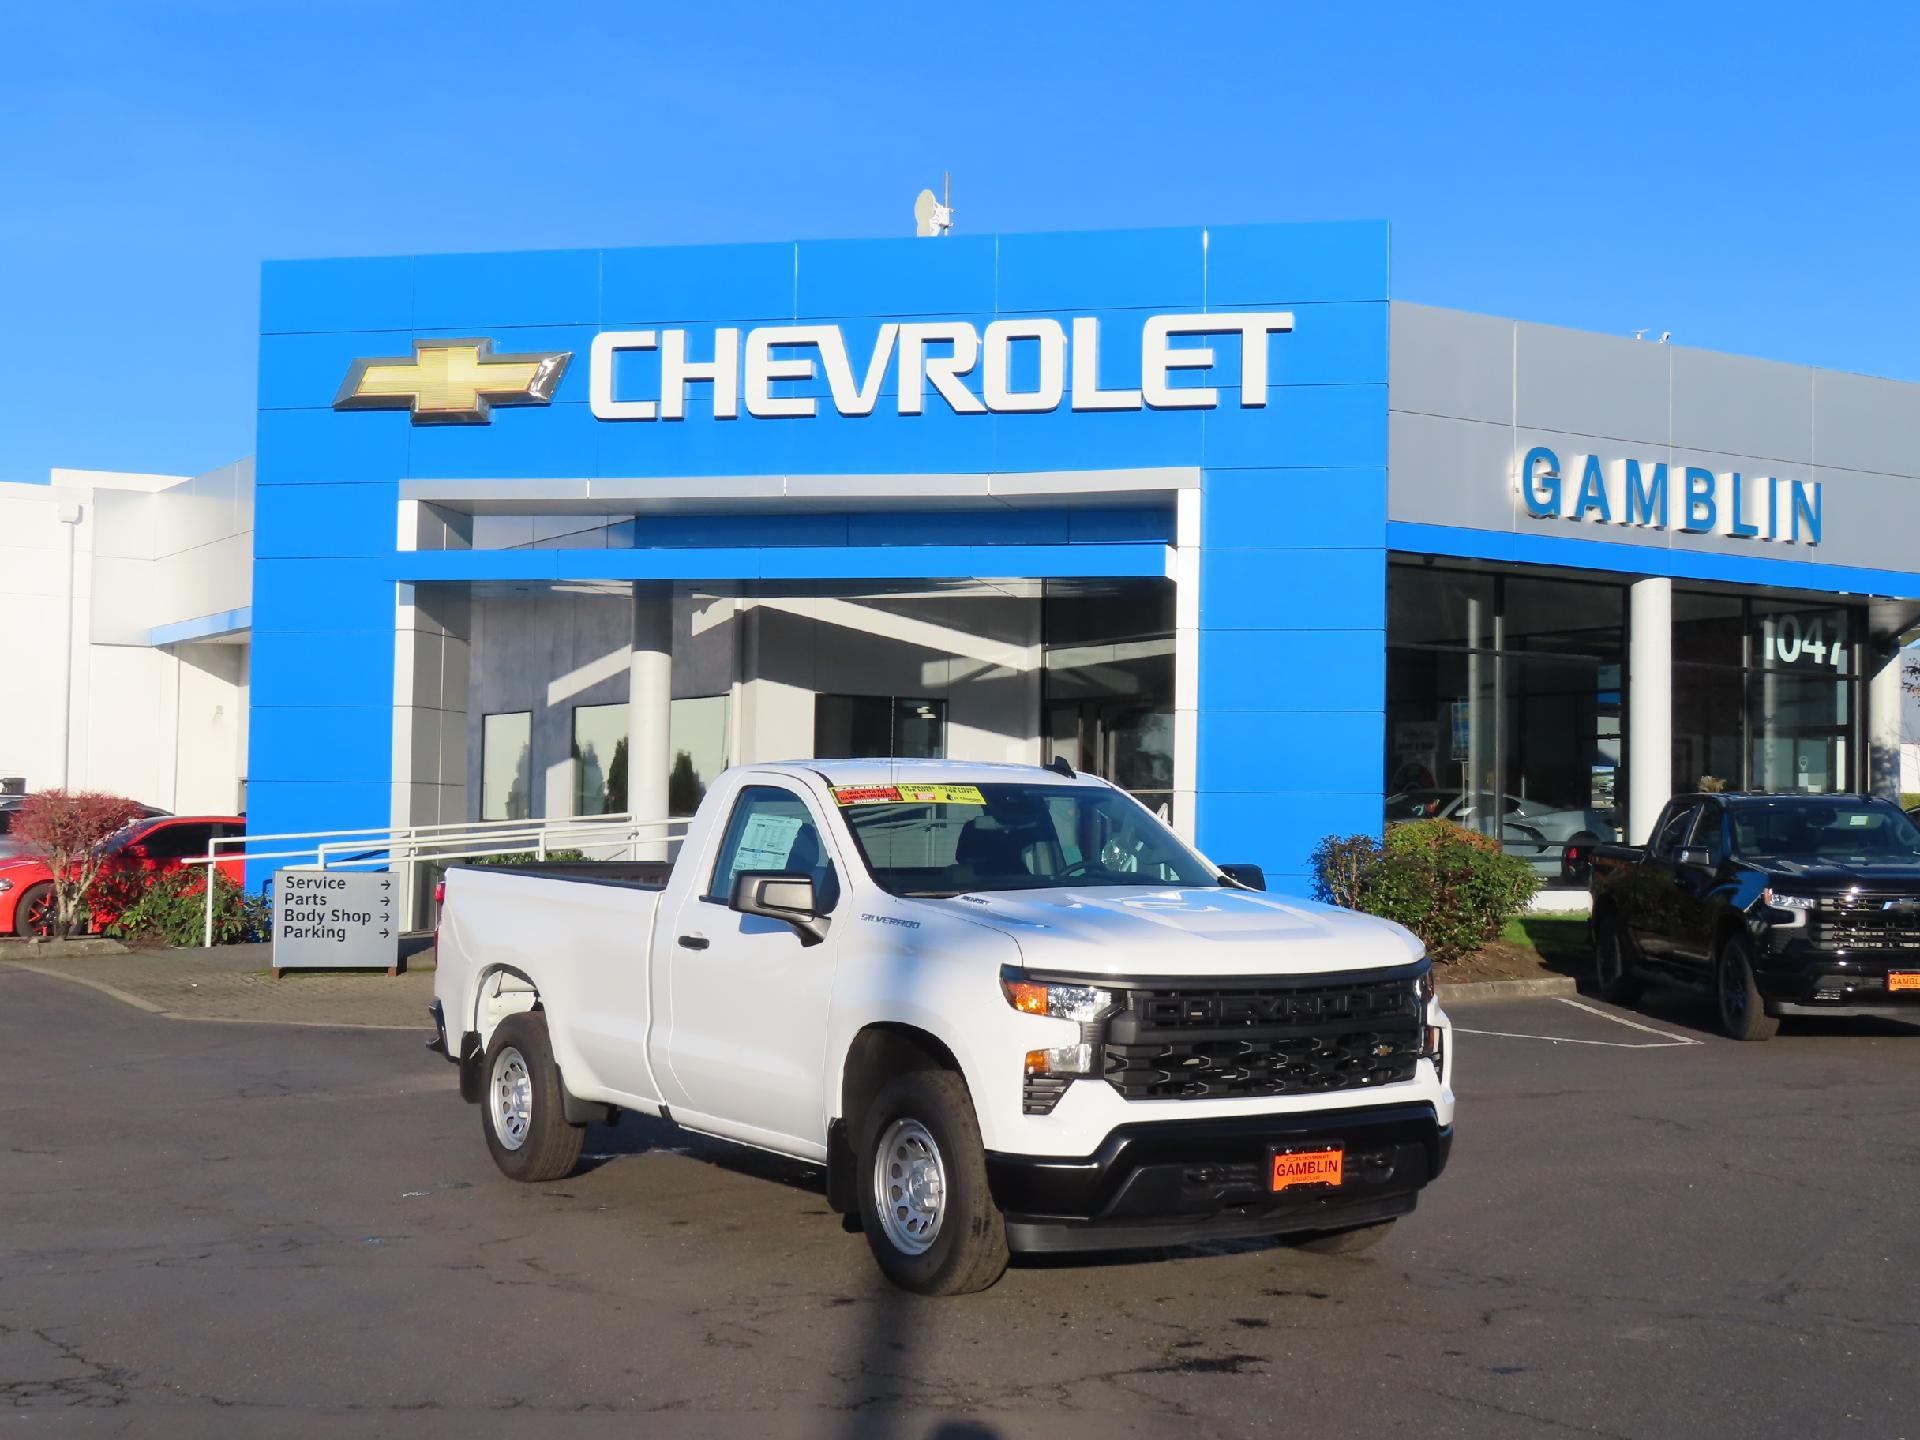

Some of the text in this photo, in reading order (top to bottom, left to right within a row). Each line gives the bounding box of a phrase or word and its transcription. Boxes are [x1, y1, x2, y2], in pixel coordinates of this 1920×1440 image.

[589, 311, 1293, 420] CHEVROLET
[1519, 446, 1823, 546] GAMBLIN
[286, 876, 346, 890] Service
[284, 892, 327, 906] Parts
[284, 908, 371, 926] Body Shop
[860, 913, 921, 929] SILVERADO
[284, 925, 346, 942] Parking
[1276, 1160, 1338, 1177] GAMBLIN
